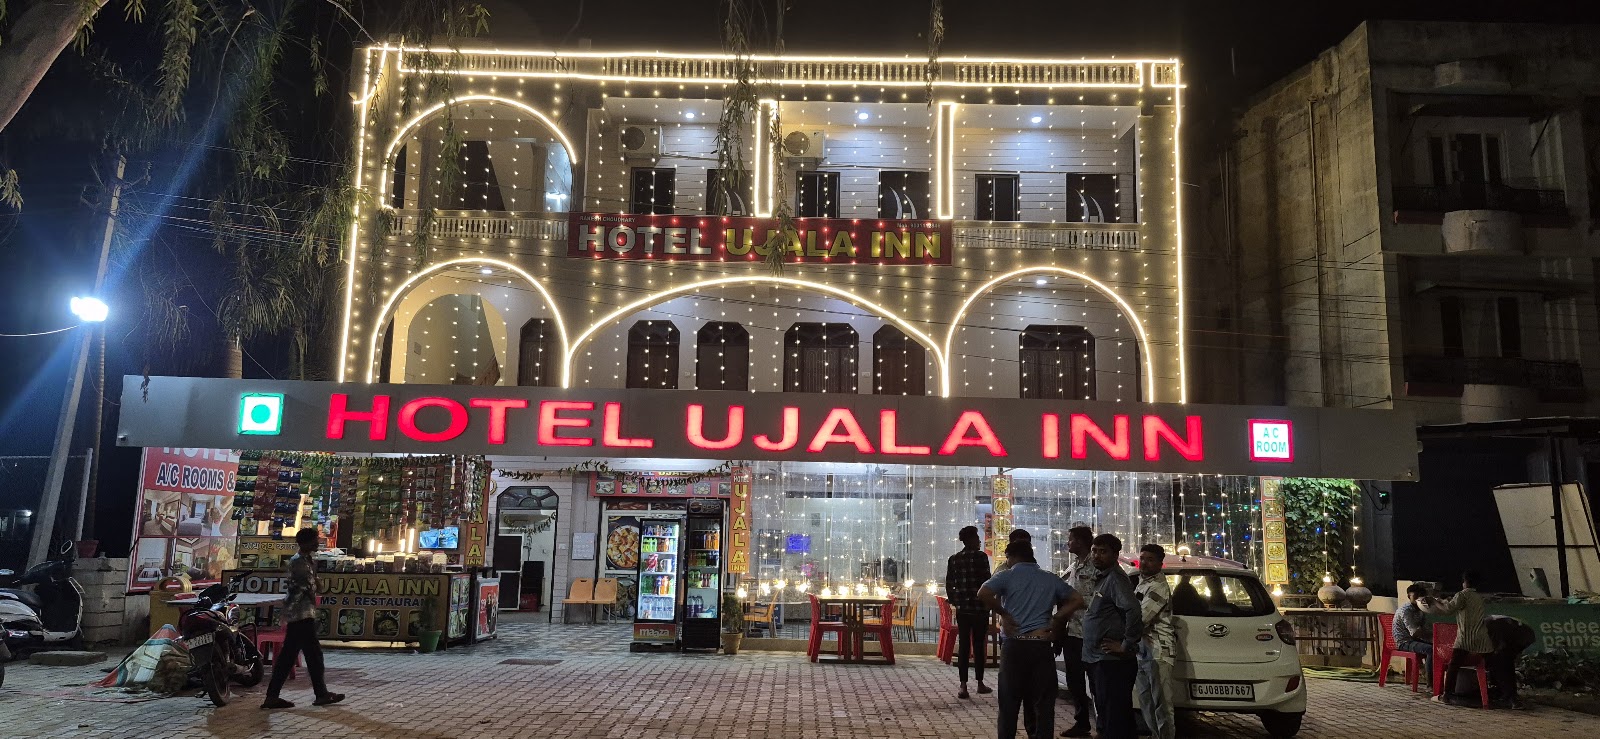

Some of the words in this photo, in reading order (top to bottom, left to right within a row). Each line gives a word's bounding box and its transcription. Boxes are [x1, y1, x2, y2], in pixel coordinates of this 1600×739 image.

[578, 224, 711, 255] HOTEL
[726, 228, 857, 257] UJALA
[871, 231, 941, 258] INN
[325, 393, 654, 448] HOTEL
[686, 403, 1008, 457] UJALA
[1040, 412, 1204, 462] INN
[1256, 440, 1287, 452] ROOM
[156, 462, 180, 486] A/C
[181, 465, 225, 491] ROOMS
[226, 471, 235, 492] &
[731, 484, 748, 563] UJALA
[398, 578, 440, 596] INN
[342, 596, 350, 606] &
[639, 628, 670, 638] maaza
[1540, 618, 1600, 634] esdee
[1542, 632, 1600, 648] paints
[1198, 685, 1251, 696] GJ08BB7667
